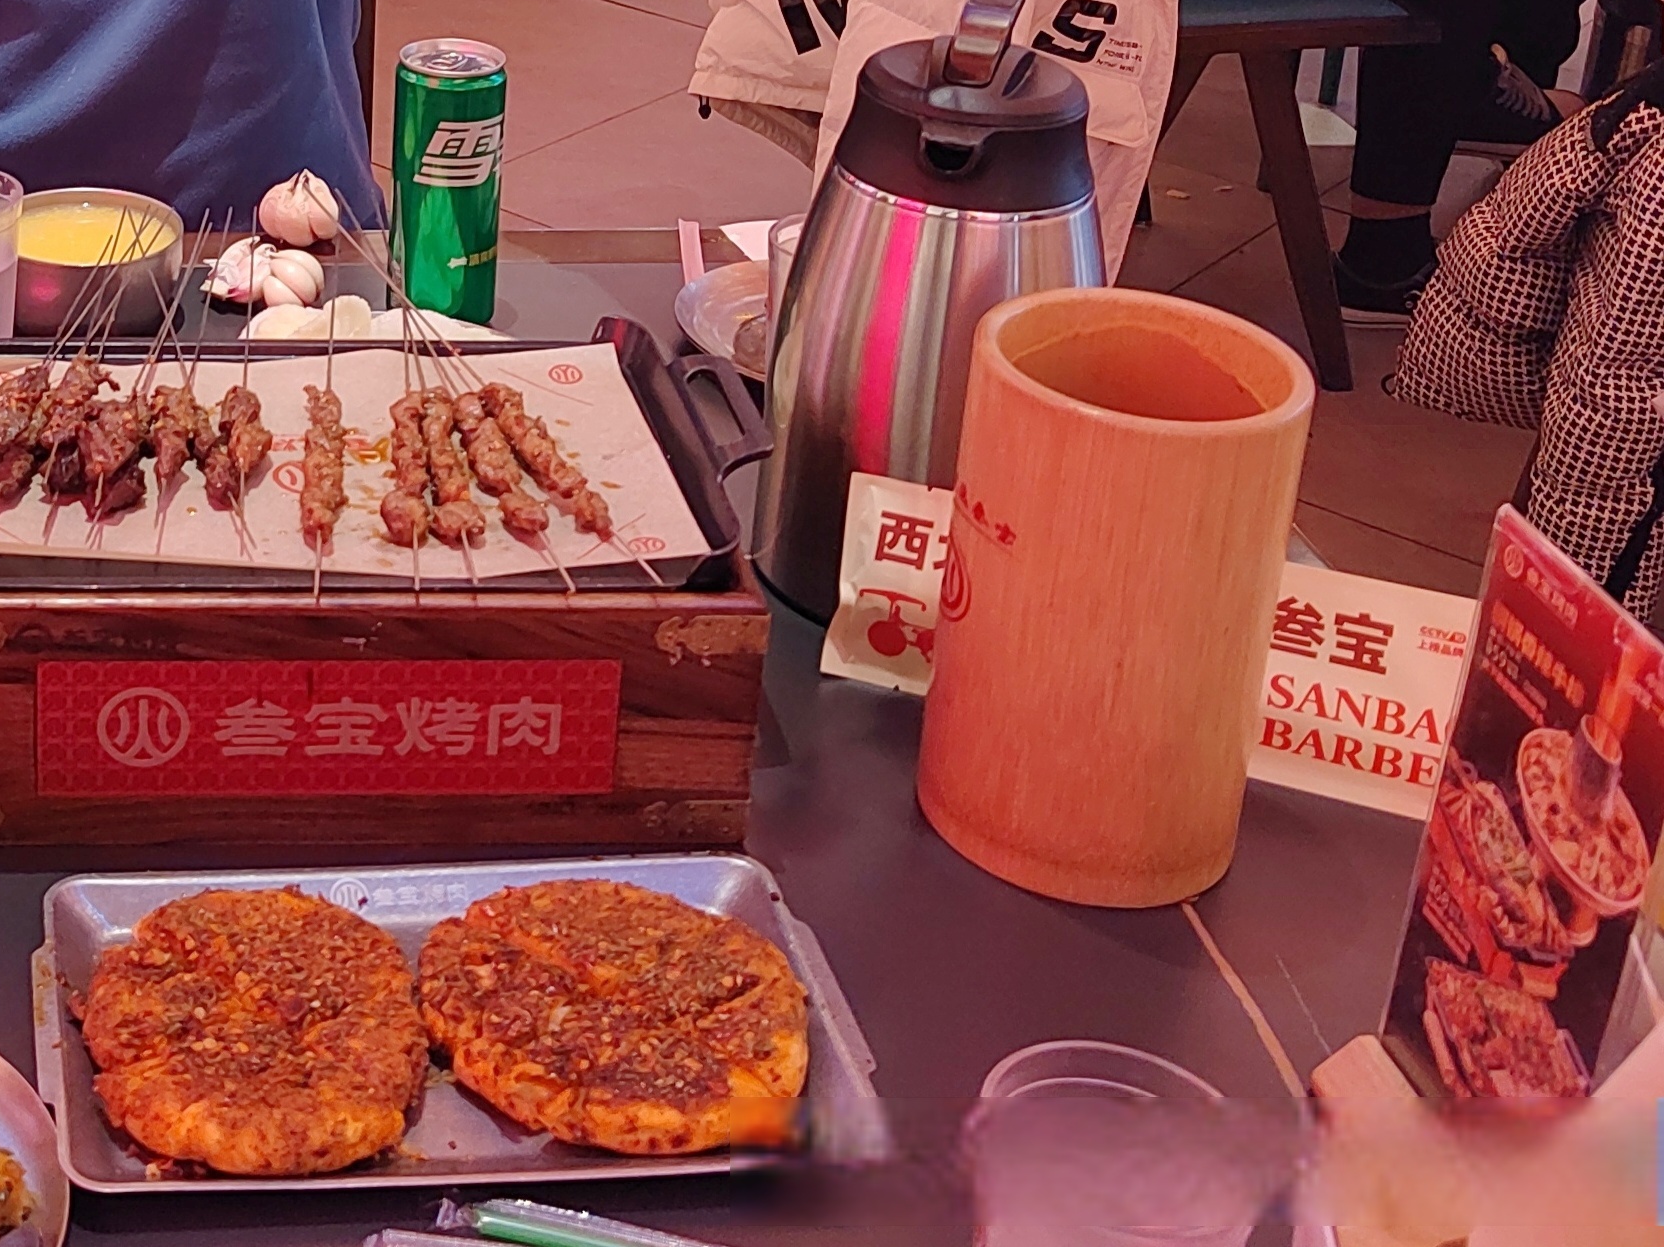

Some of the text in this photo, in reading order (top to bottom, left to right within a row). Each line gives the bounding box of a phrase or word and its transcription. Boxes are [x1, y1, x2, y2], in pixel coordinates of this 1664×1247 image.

[413, 113, 504, 187] 雪
[214, 696, 563, 756] 叁宝烤肉
